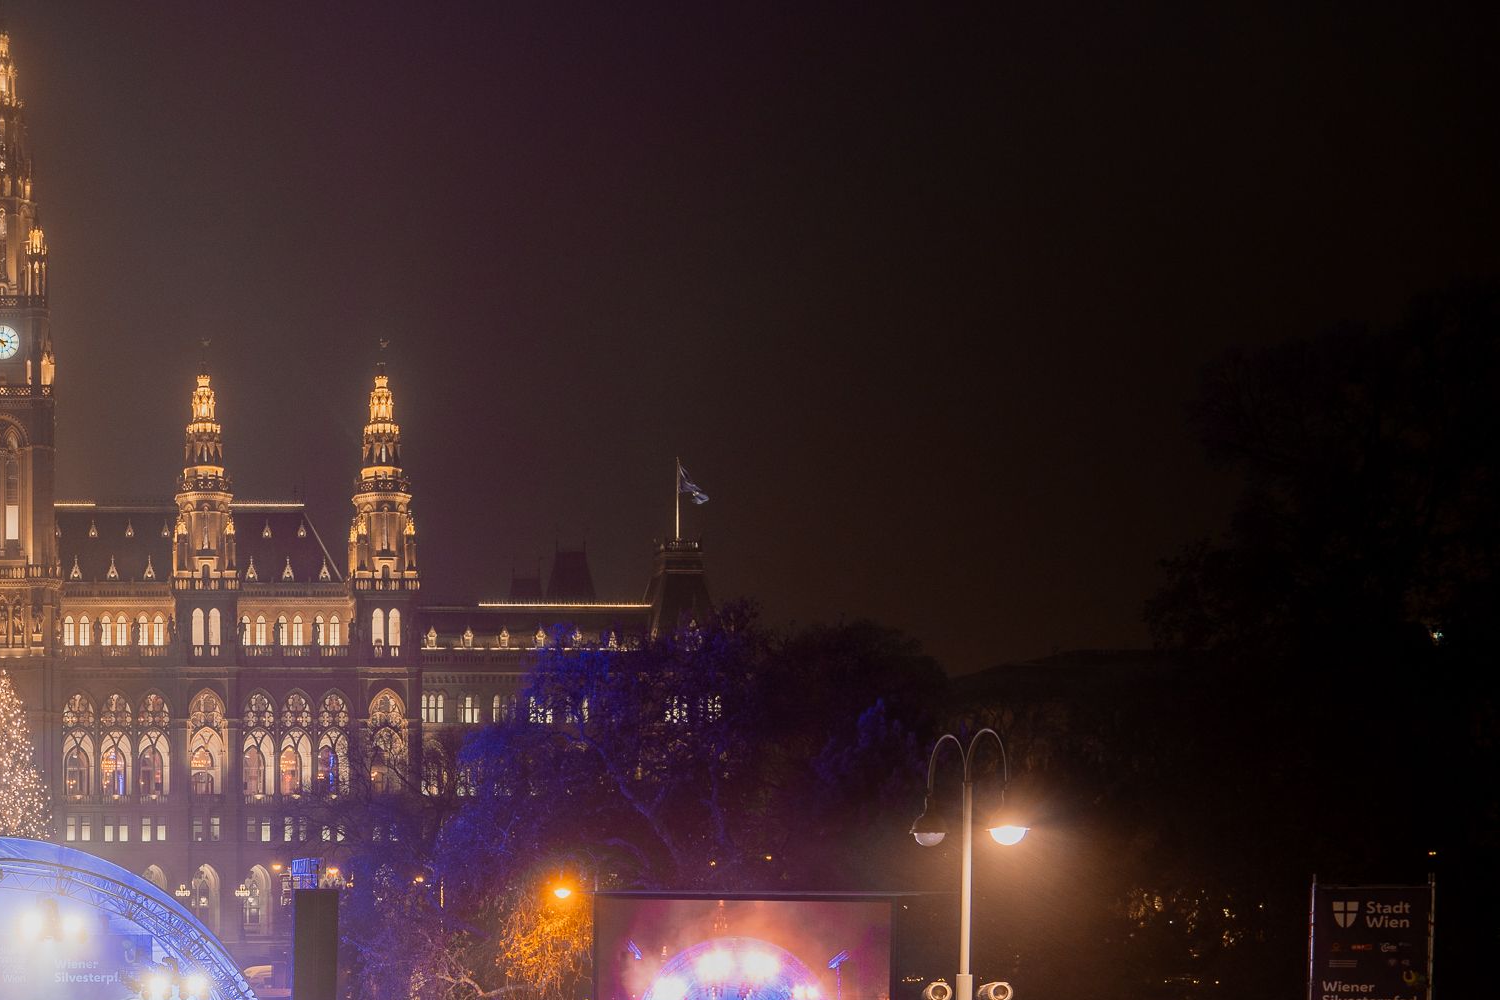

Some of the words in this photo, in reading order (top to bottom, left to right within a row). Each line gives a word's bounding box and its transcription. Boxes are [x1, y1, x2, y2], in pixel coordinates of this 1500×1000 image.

[1366, 901, 1411, 914] Stadt
[1366, 915, 1410, 928] Wien
[1322, 981, 1375, 992] Wiener
